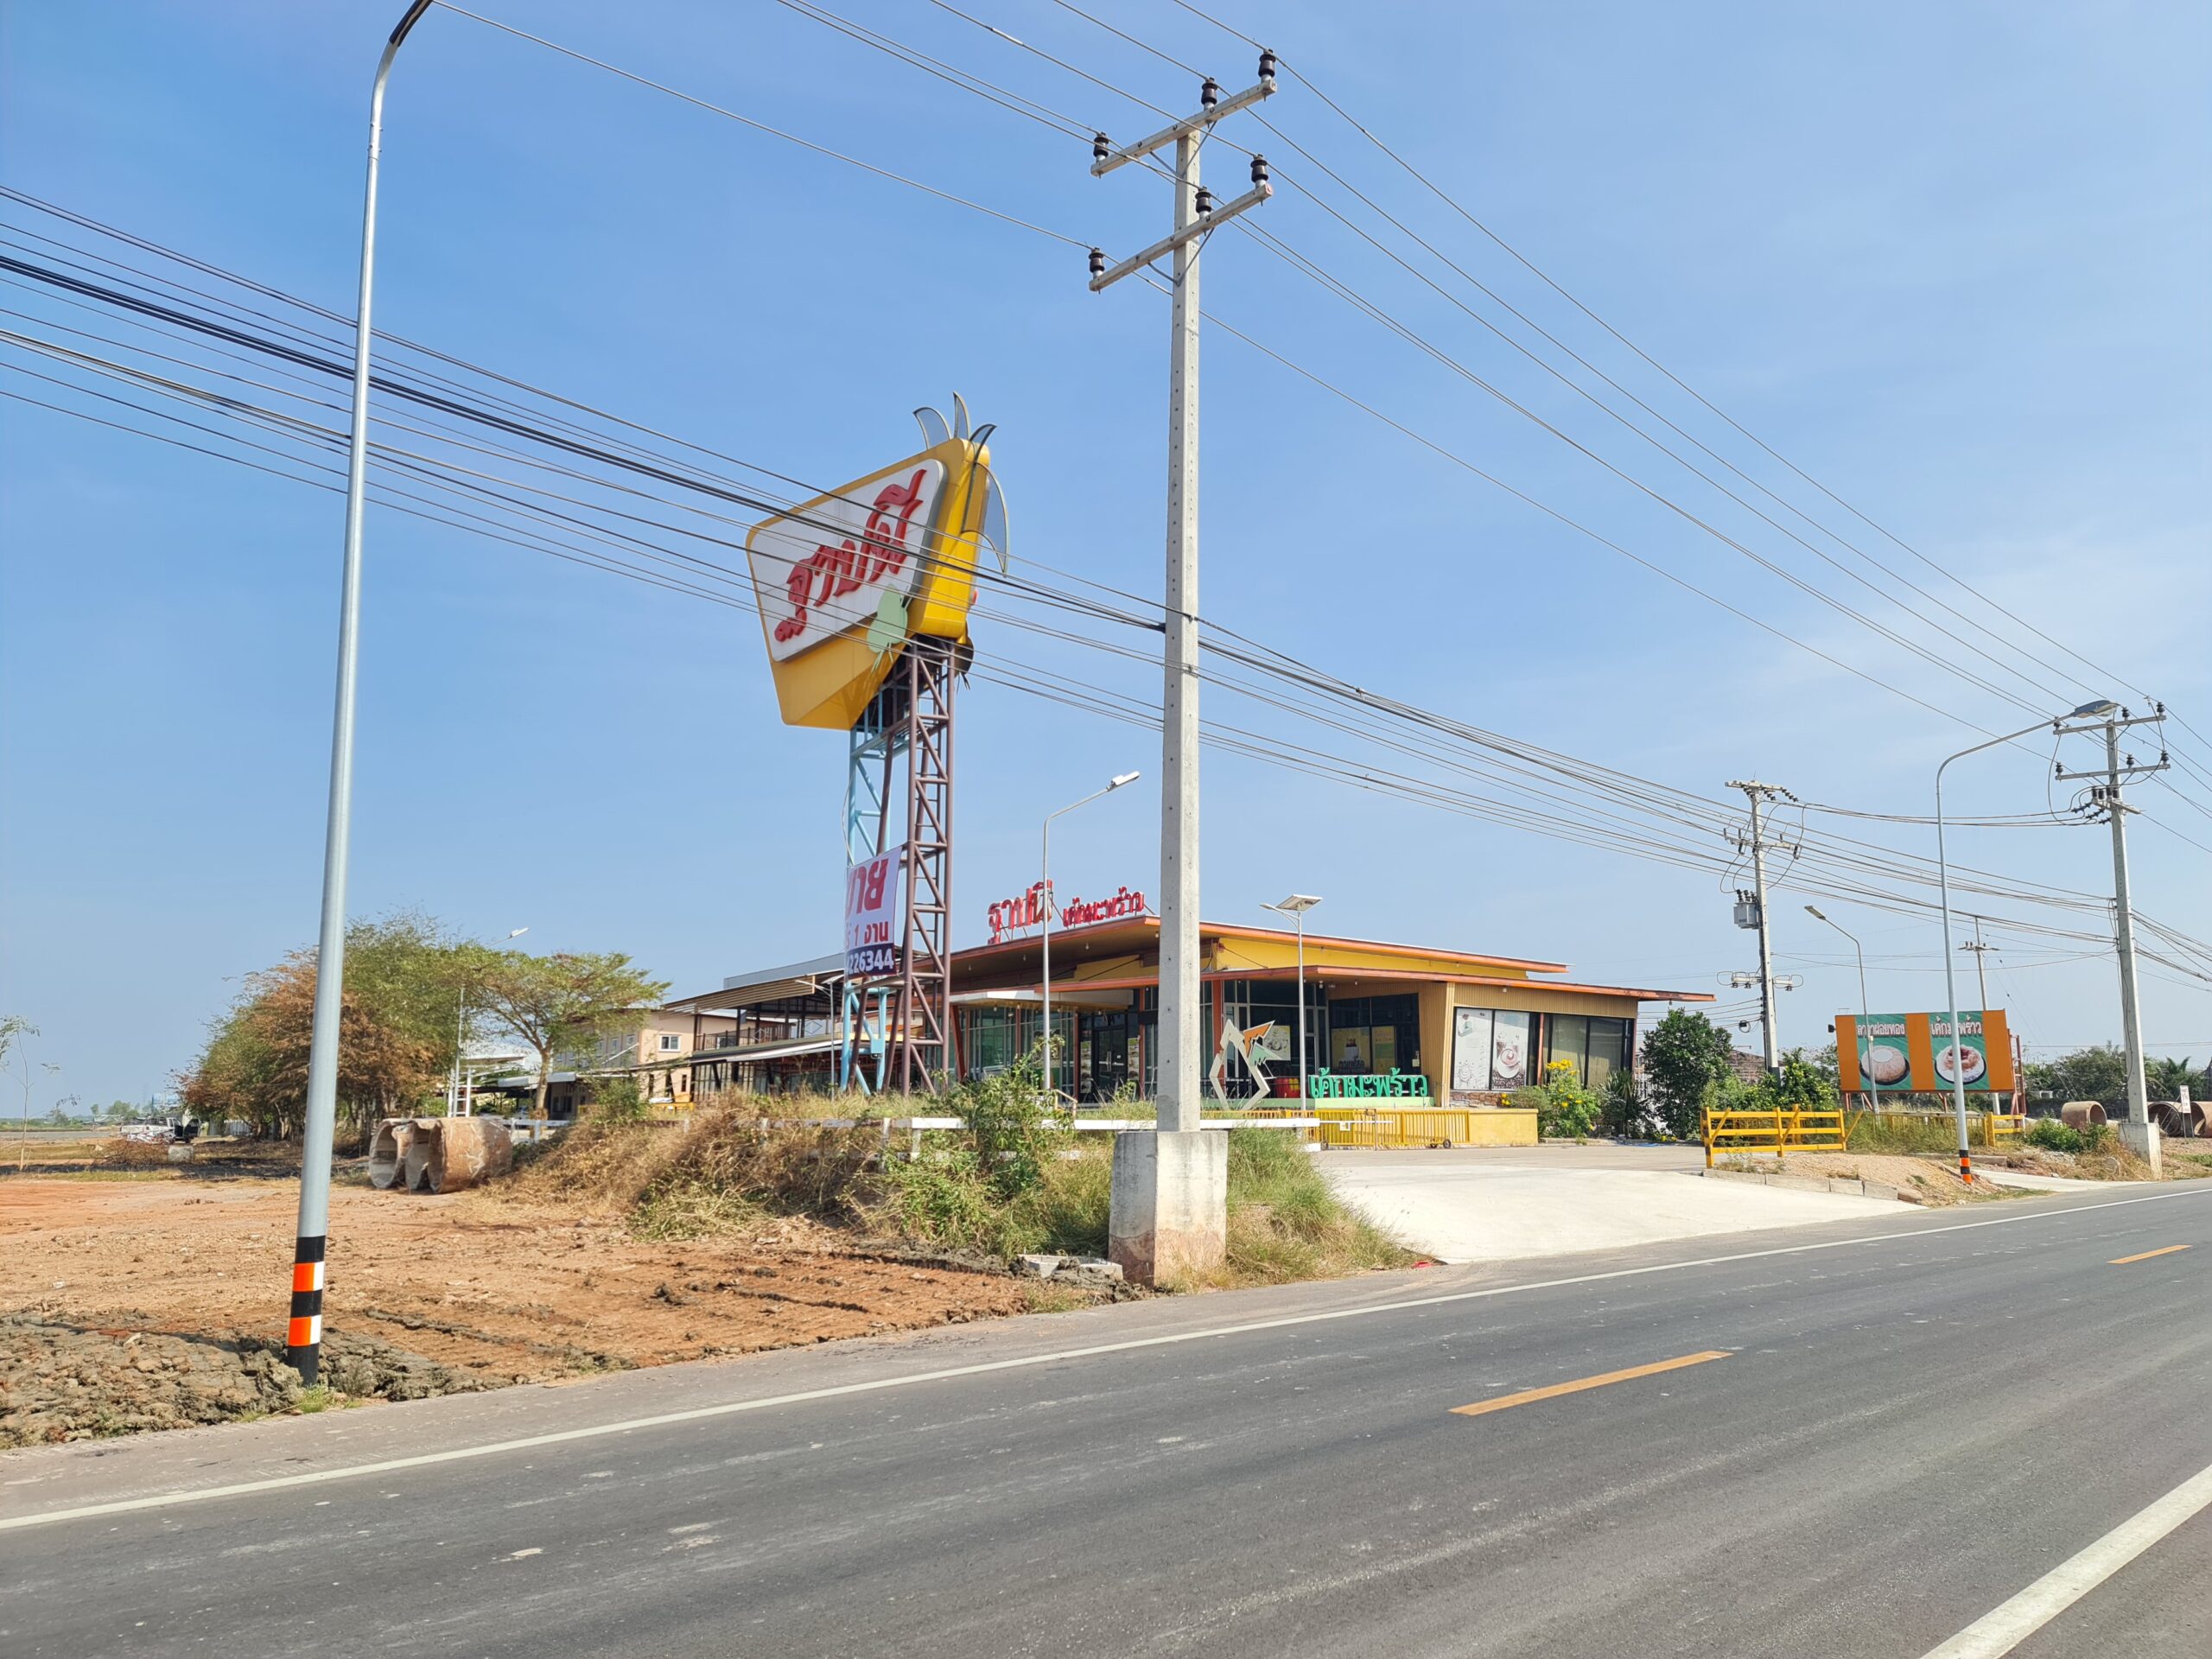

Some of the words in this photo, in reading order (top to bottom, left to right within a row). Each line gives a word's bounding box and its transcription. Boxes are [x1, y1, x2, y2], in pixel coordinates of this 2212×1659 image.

[864, 921, 889, 944] งาน
[1308, 1067, 1429, 1098] เค้กมะพร้าว
